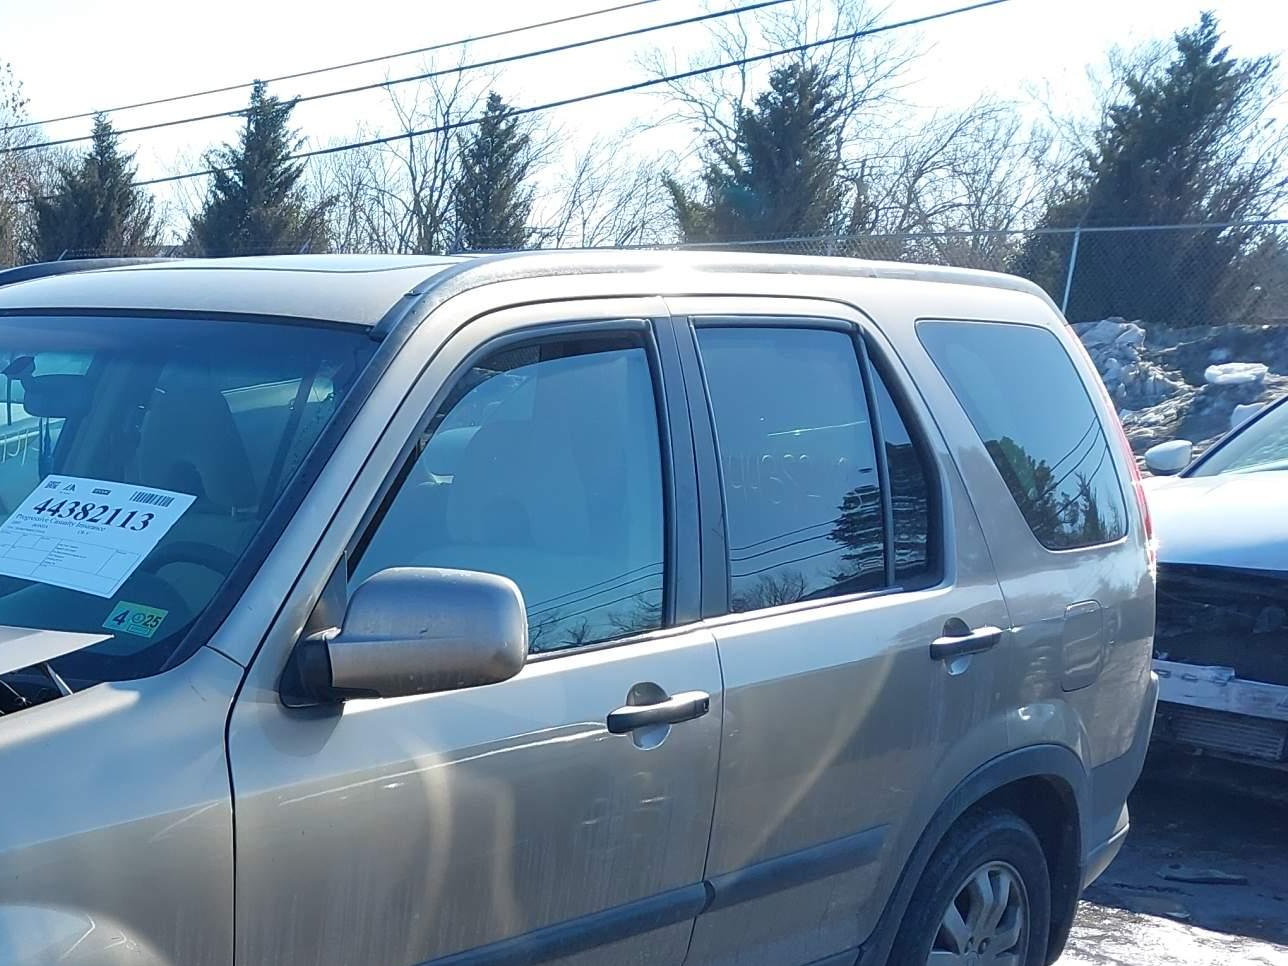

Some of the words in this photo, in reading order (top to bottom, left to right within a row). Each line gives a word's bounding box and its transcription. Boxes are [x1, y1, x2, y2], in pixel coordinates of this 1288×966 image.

[33, 498, 156, 532] 44382113
[112, 609, 131, 626] 4
[142, 614, 162, 628] 25
